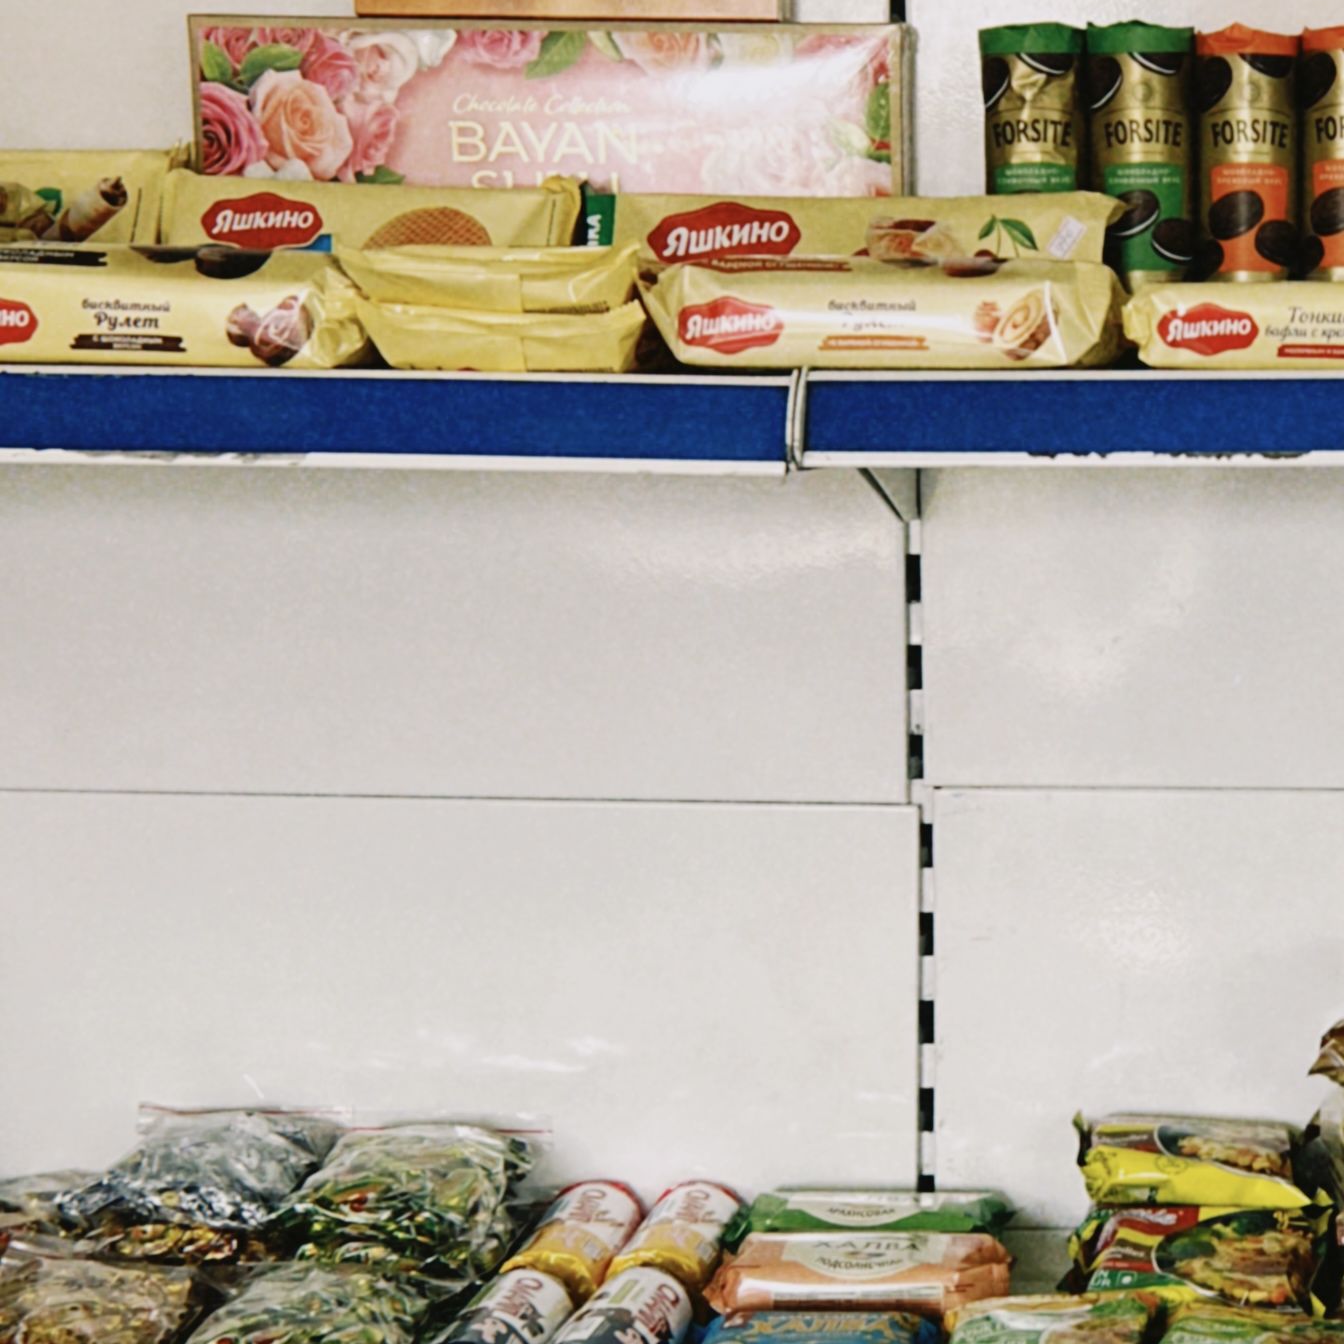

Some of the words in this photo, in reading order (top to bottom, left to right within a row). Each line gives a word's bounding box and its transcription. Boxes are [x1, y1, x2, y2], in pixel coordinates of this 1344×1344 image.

[452, 93, 536, 114] Chocolate
[449, 122, 638, 164] BAYAN
[992, 118, 1072, 149] FORSITE
[1104, 117, 1184, 148] FORSITE
[1210, 119, 1290, 150] FORSITE
[212, 206, 315, 236] Яшкино
[662, 219, 790, 258] Яшкино
[81, 297, 171, 313] бисквитный
[827, 299, 917, 315] бисквитный
[94, 310, 160, 330] Рулет
[686, 311, 780, 338] Яшкино
[1166, 315, 1252, 343] Яшкино
[1264, 323, 1308, 343] вафли
[814, 1239, 921, 1252] ХАЛВА
